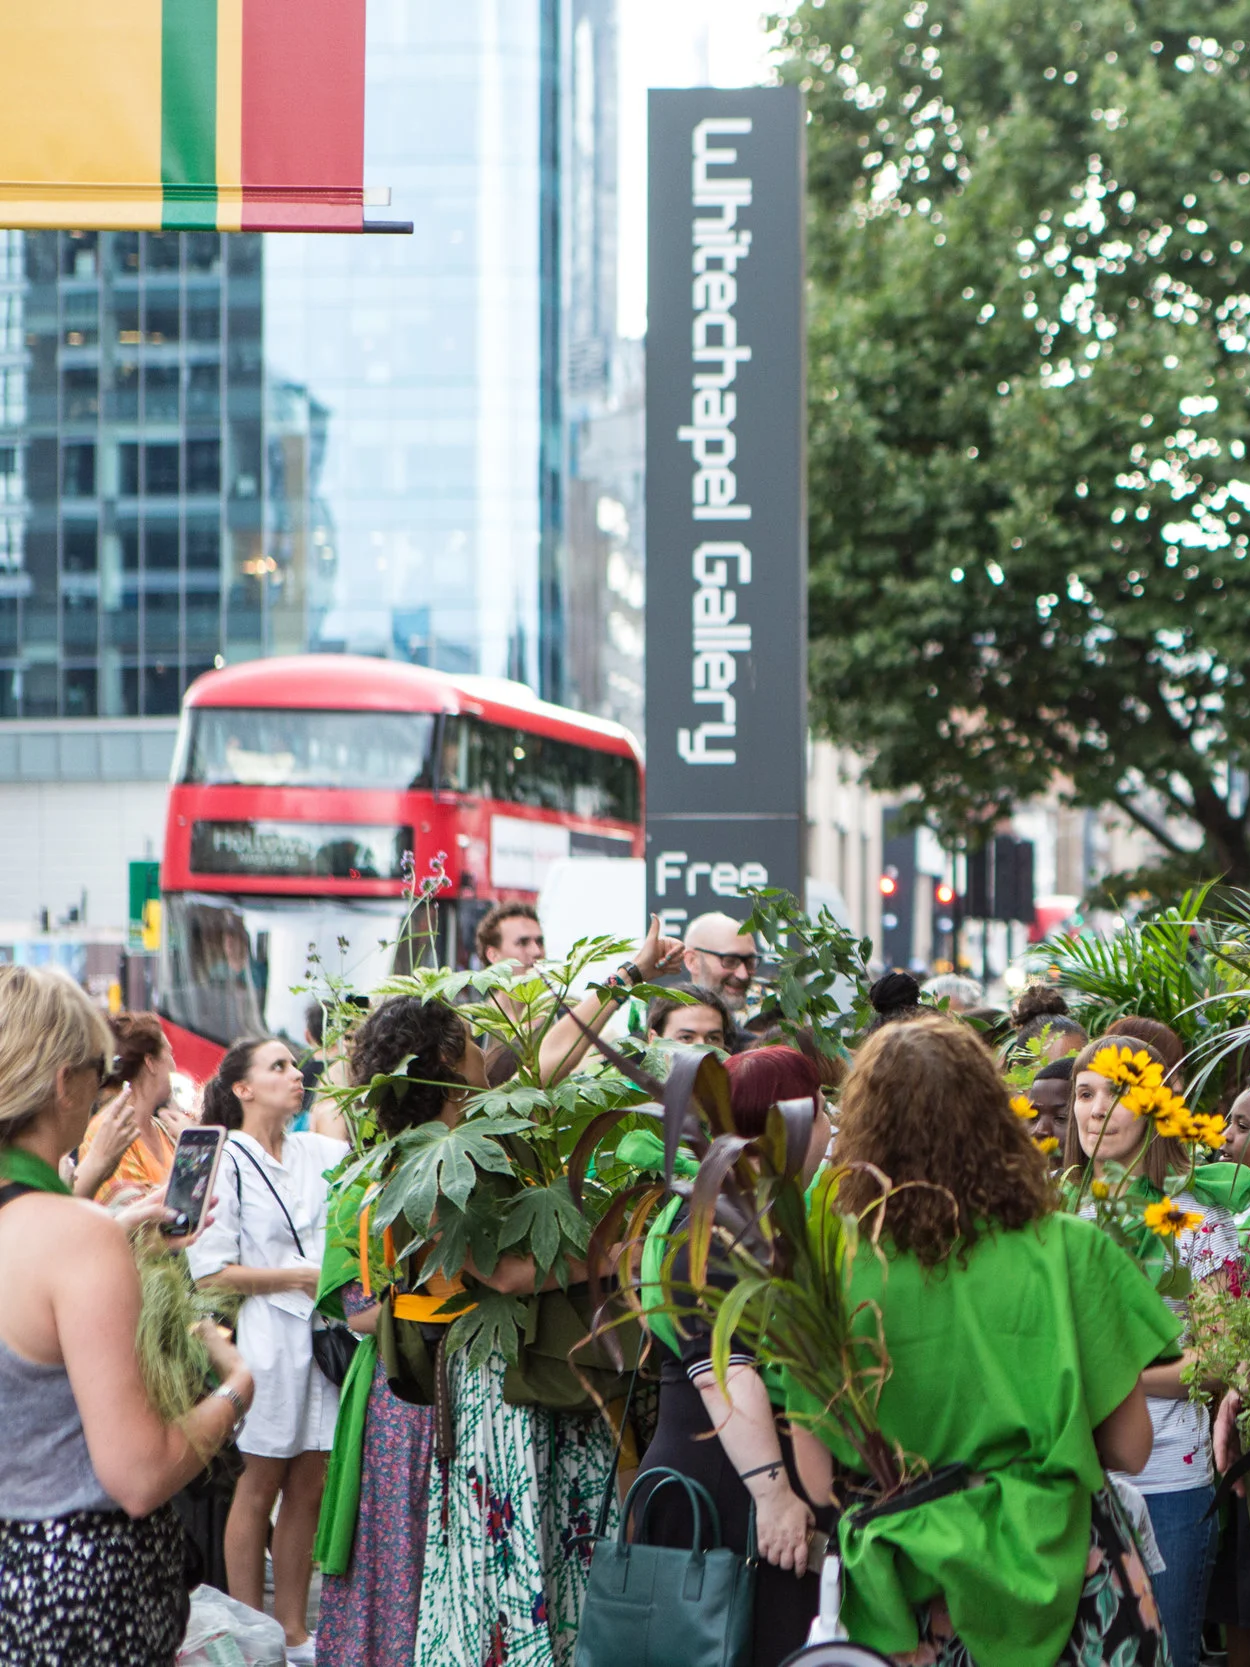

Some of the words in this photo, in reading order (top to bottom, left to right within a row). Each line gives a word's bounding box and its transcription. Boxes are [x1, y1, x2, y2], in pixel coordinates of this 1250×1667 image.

[676, 117, 753, 521] Whitechapel
[676, 540, 753, 765] Gallery
[655, 851, 769, 898] Free
